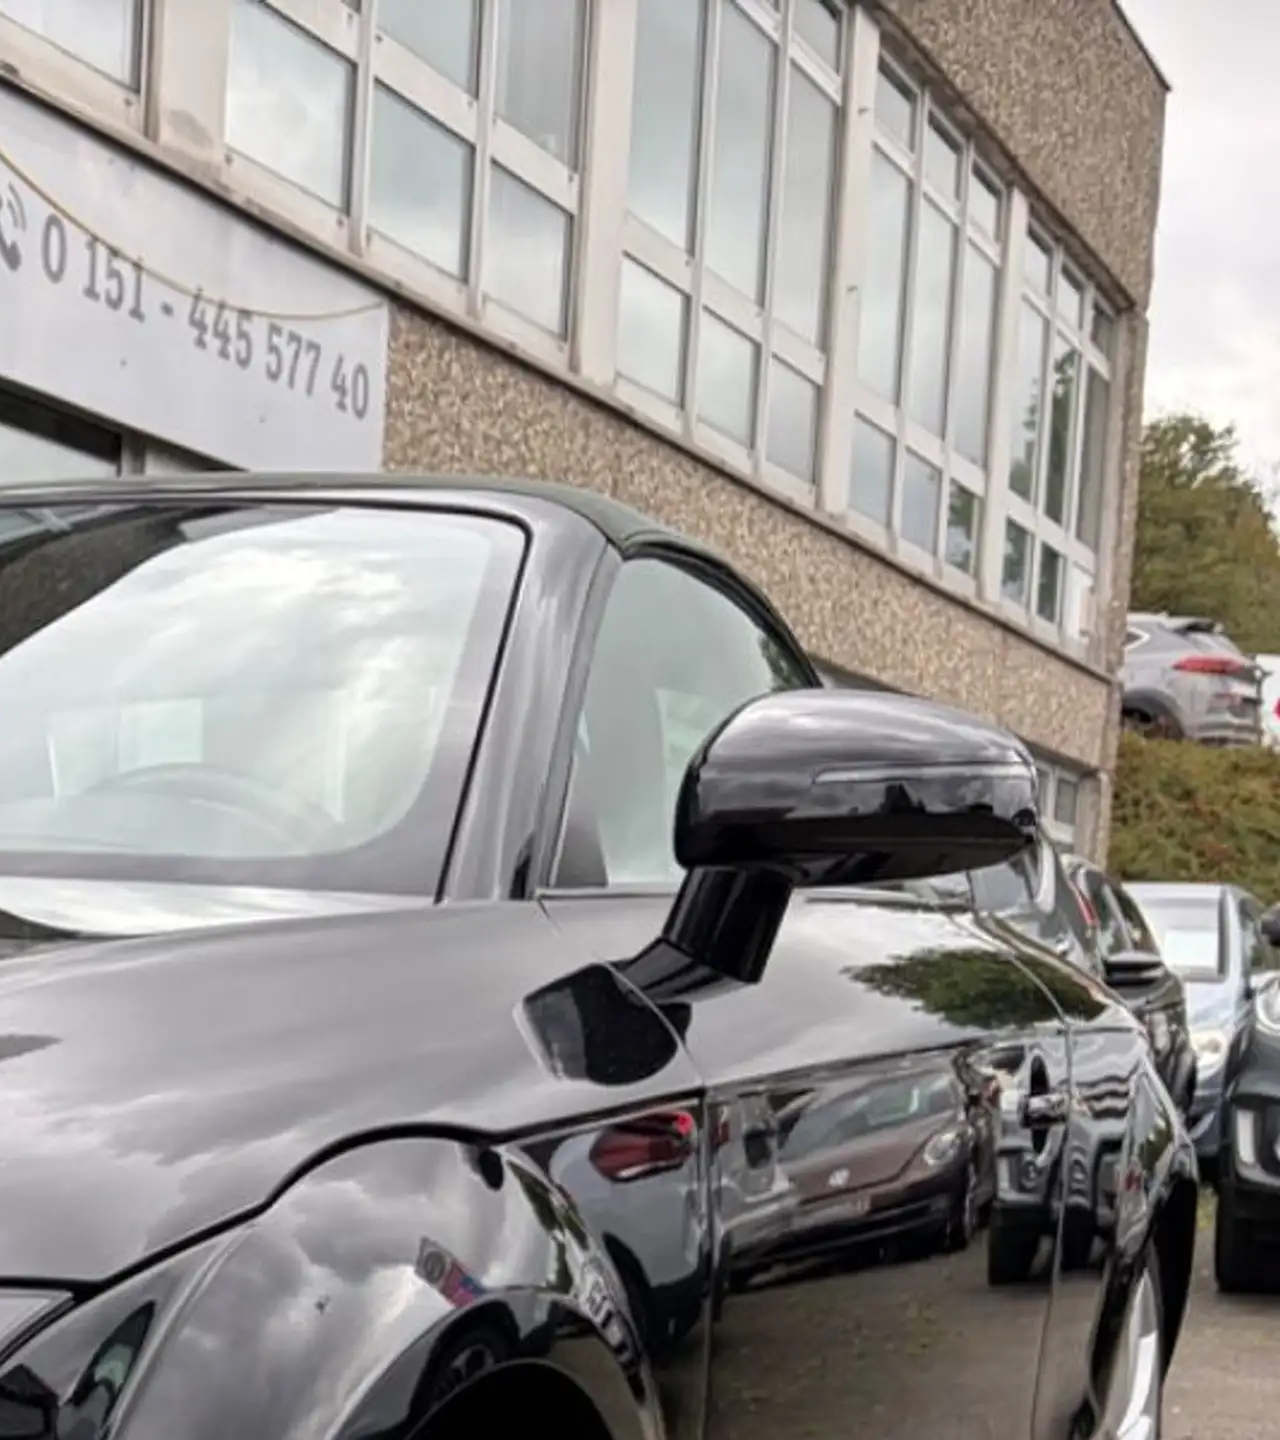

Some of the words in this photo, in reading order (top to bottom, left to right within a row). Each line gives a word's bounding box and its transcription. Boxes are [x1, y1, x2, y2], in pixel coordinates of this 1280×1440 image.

[188, 286, 254, 369] 445
[266, 321, 322, 397] 577
[331, 354, 370, 421] 40
